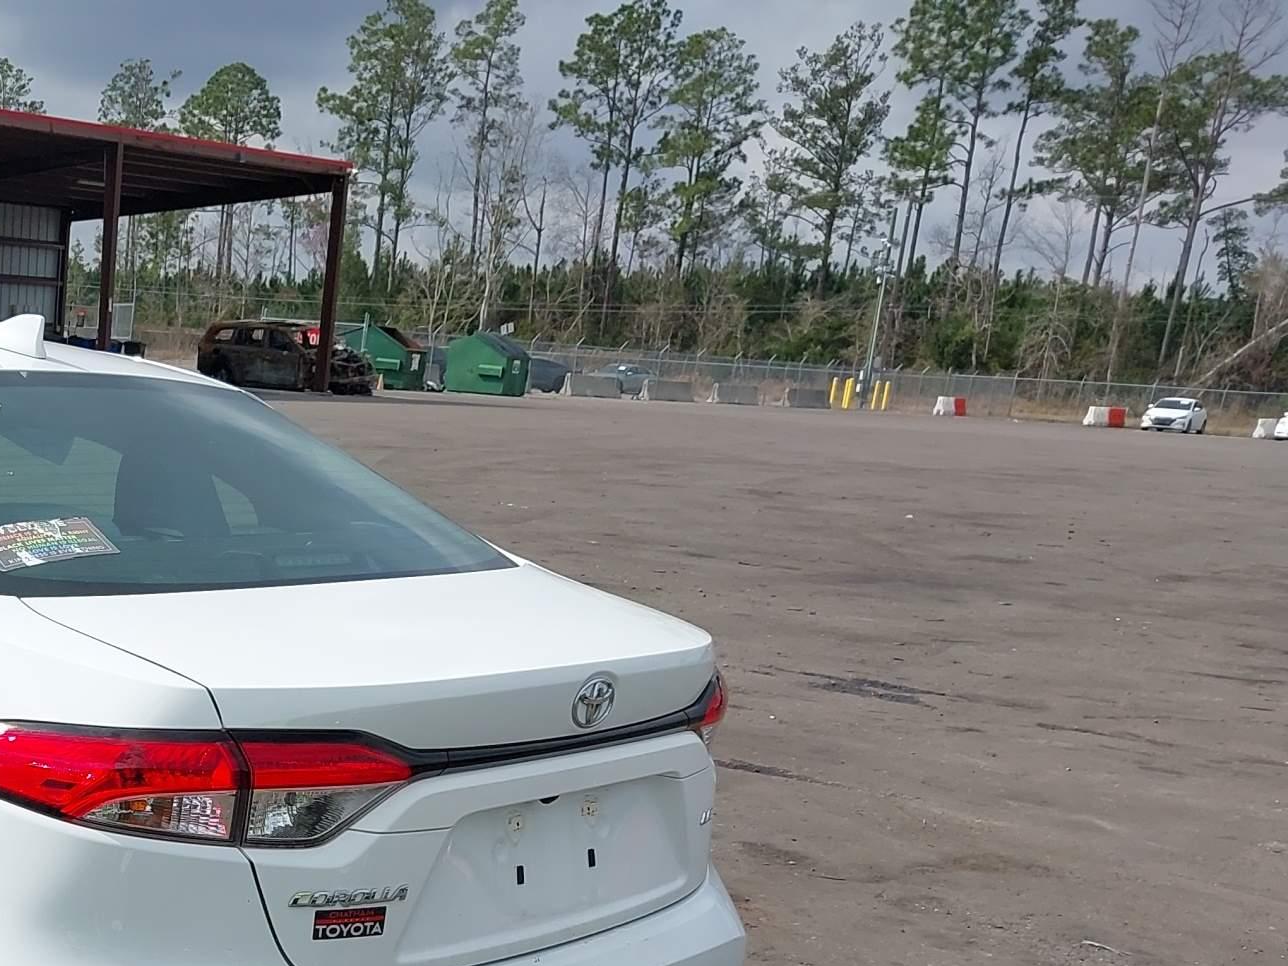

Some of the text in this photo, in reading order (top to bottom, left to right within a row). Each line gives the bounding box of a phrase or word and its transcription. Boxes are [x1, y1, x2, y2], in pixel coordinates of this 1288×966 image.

[288, 884, 408, 907] COROLLA
[329, 909, 375, 919] CHATHAM
[315, 921, 382, 939] TOYOTA
